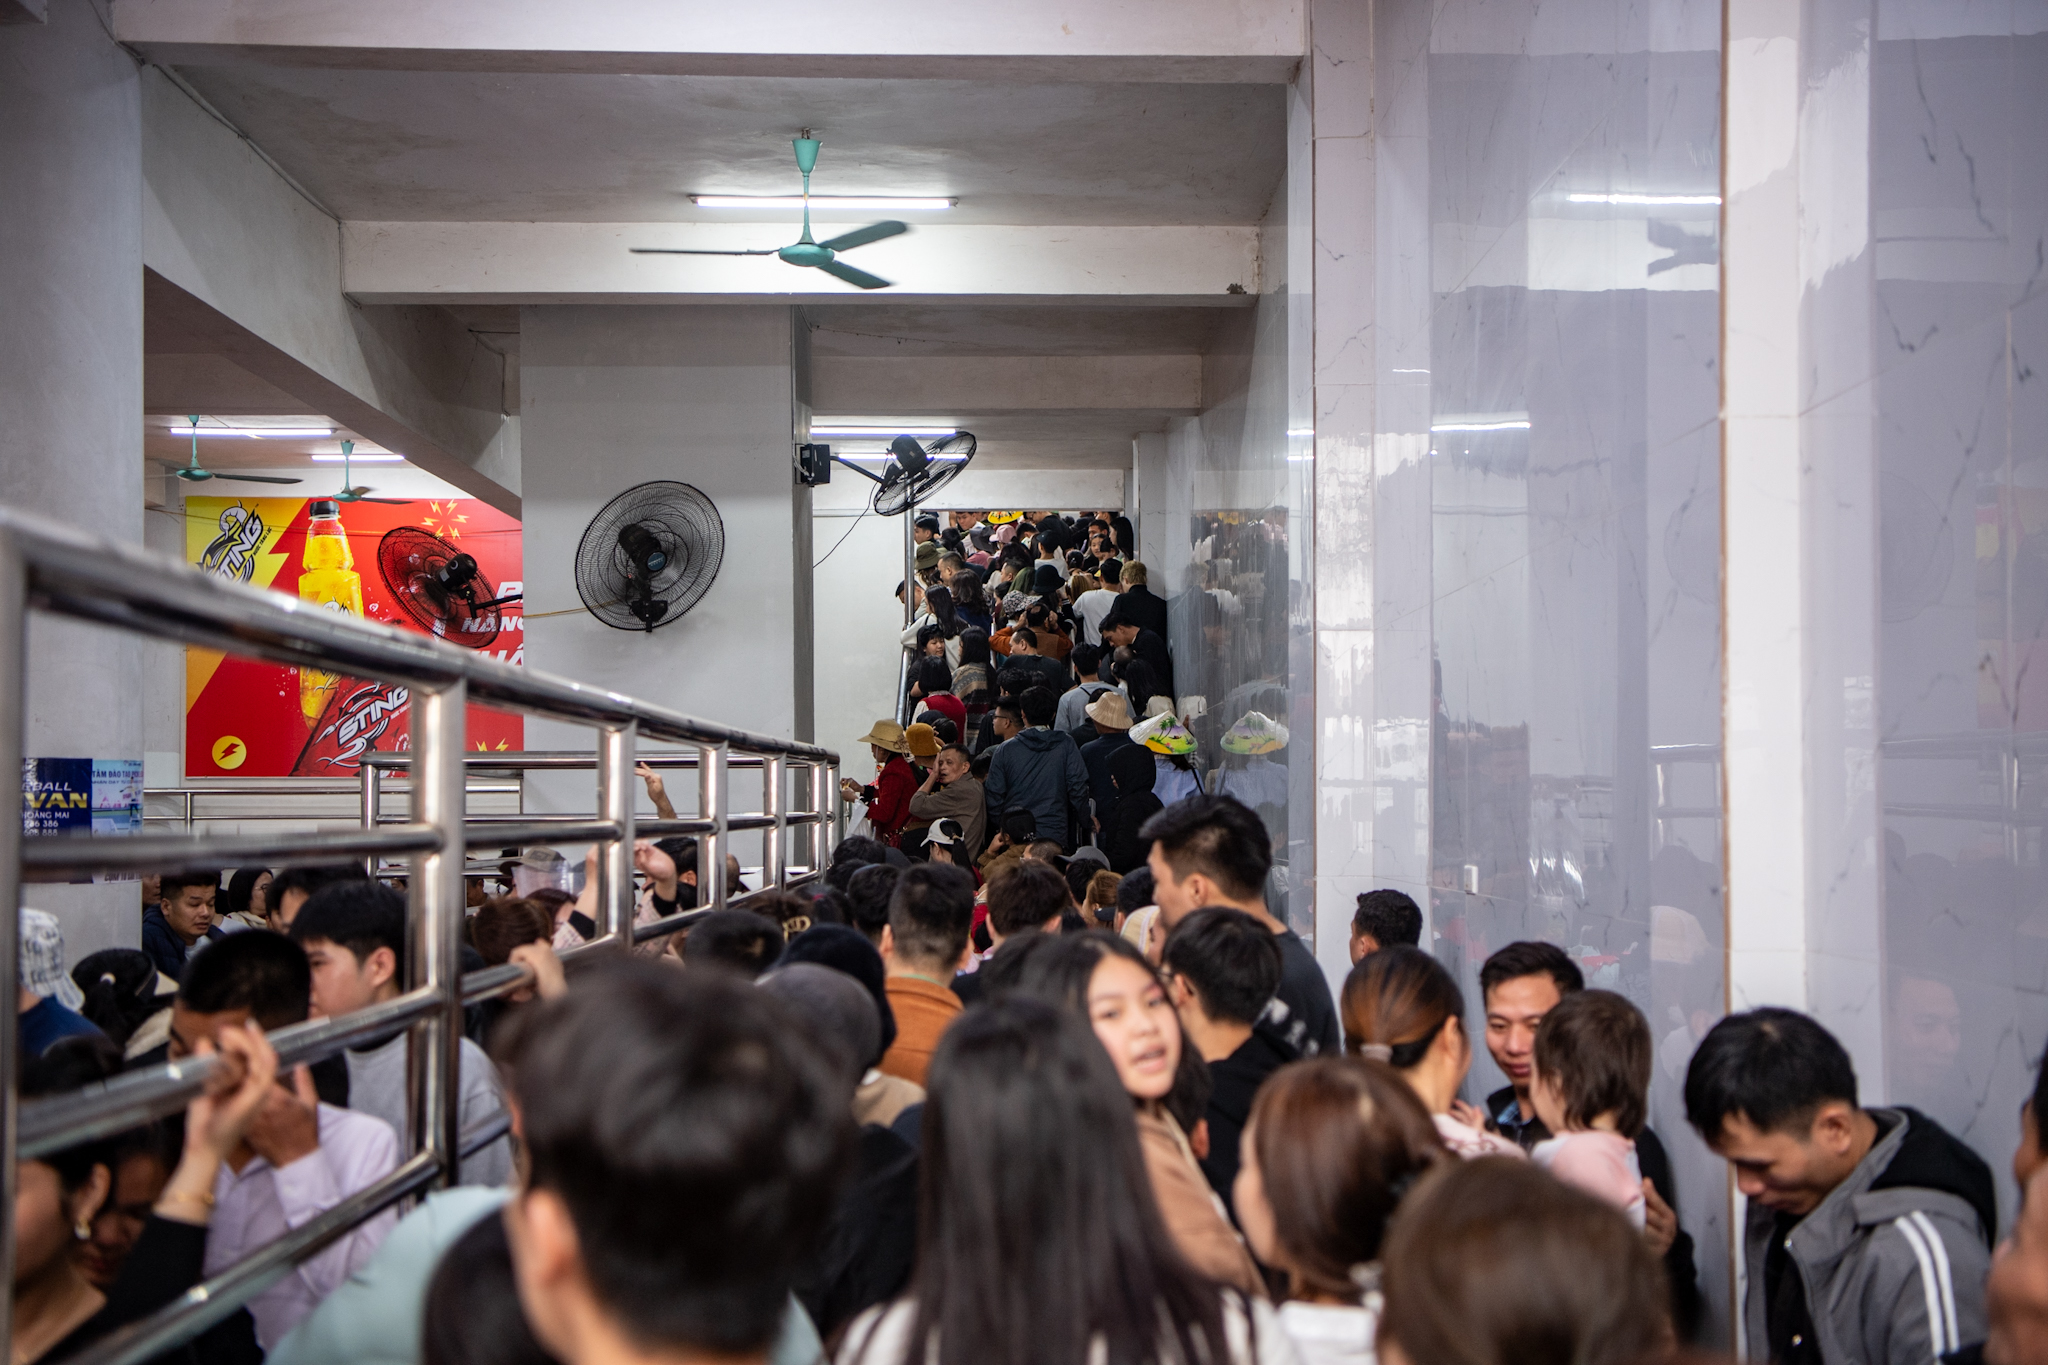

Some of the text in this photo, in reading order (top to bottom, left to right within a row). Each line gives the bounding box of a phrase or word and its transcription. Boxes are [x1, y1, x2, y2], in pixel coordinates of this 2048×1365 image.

[217, 508, 263, 581] TING
[338, 686, 409, 746] STING
[42, 819, 59, 828] 386
[55, 811, 70, 819] MAI
